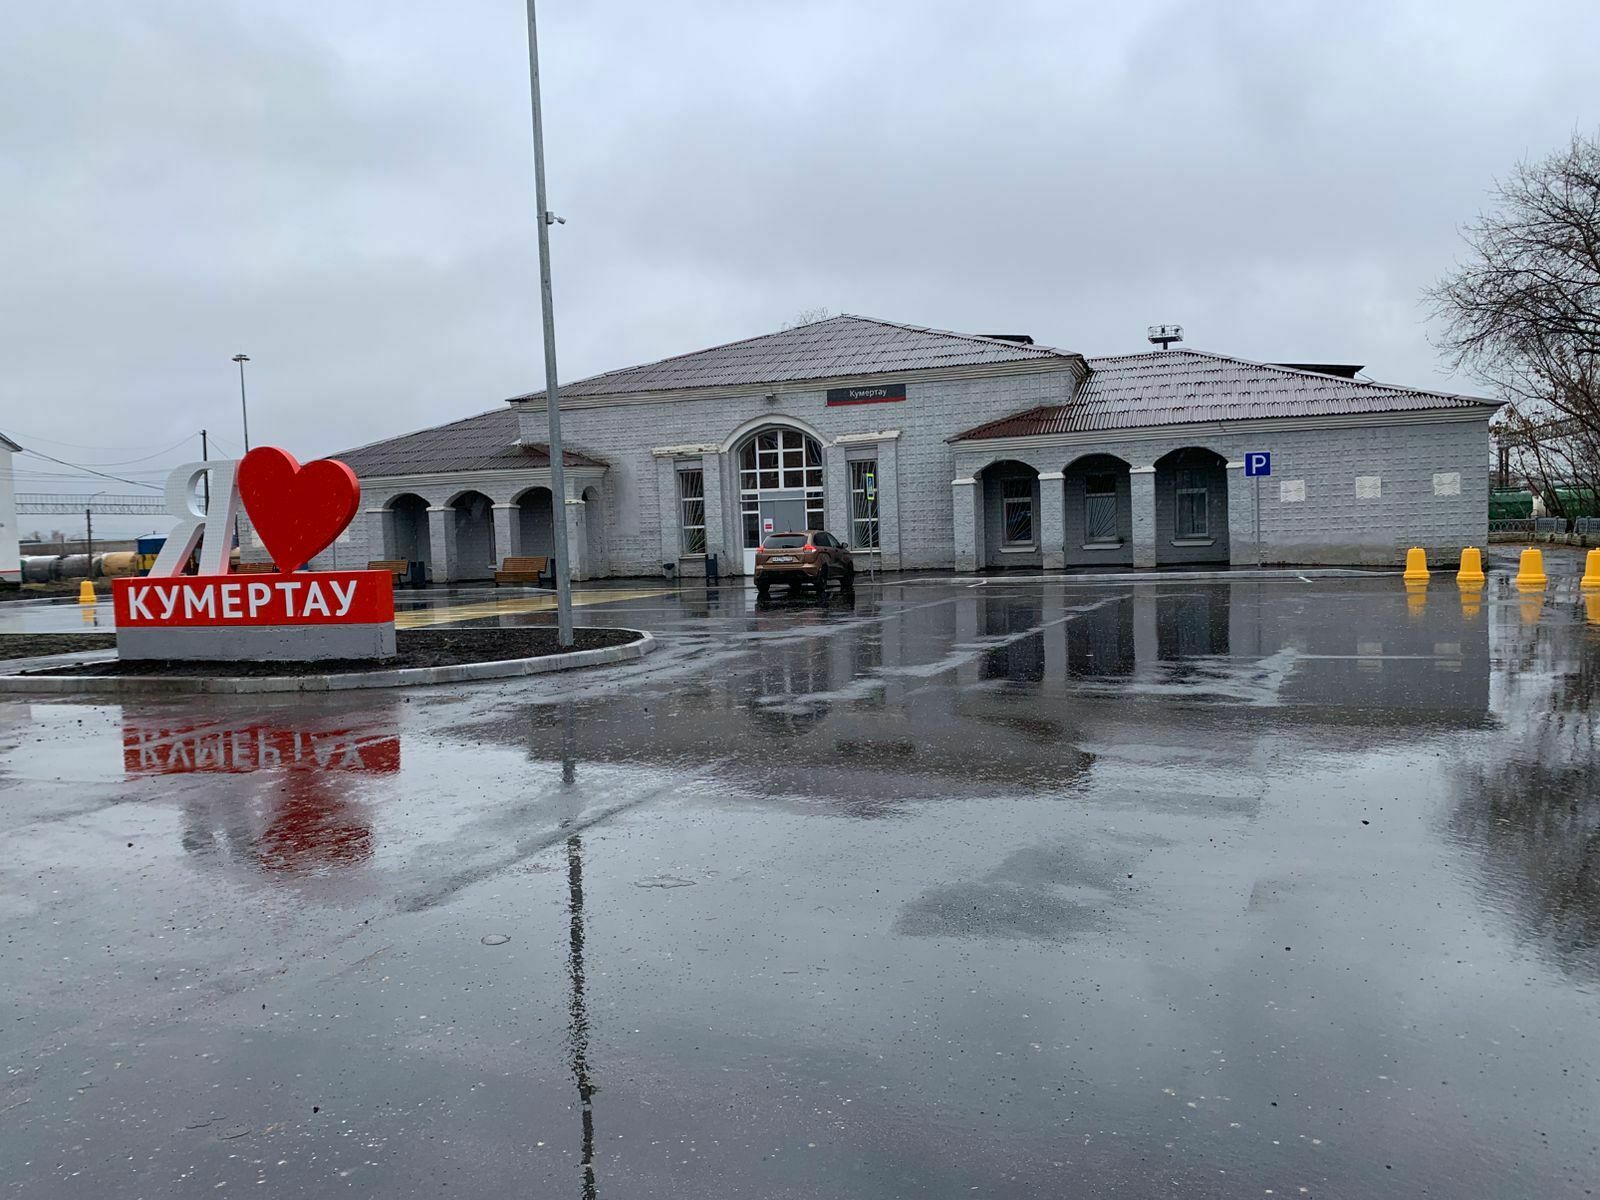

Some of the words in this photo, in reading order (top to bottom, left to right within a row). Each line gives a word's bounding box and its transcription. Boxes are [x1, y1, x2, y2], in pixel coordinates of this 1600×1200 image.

[849, 389, 888, 399] Кумертау
[1252, 455, 1267, 474] P
[147, 460, 239, 577] Я
[127, 580, 358, 620] КУМЕРТАУ
